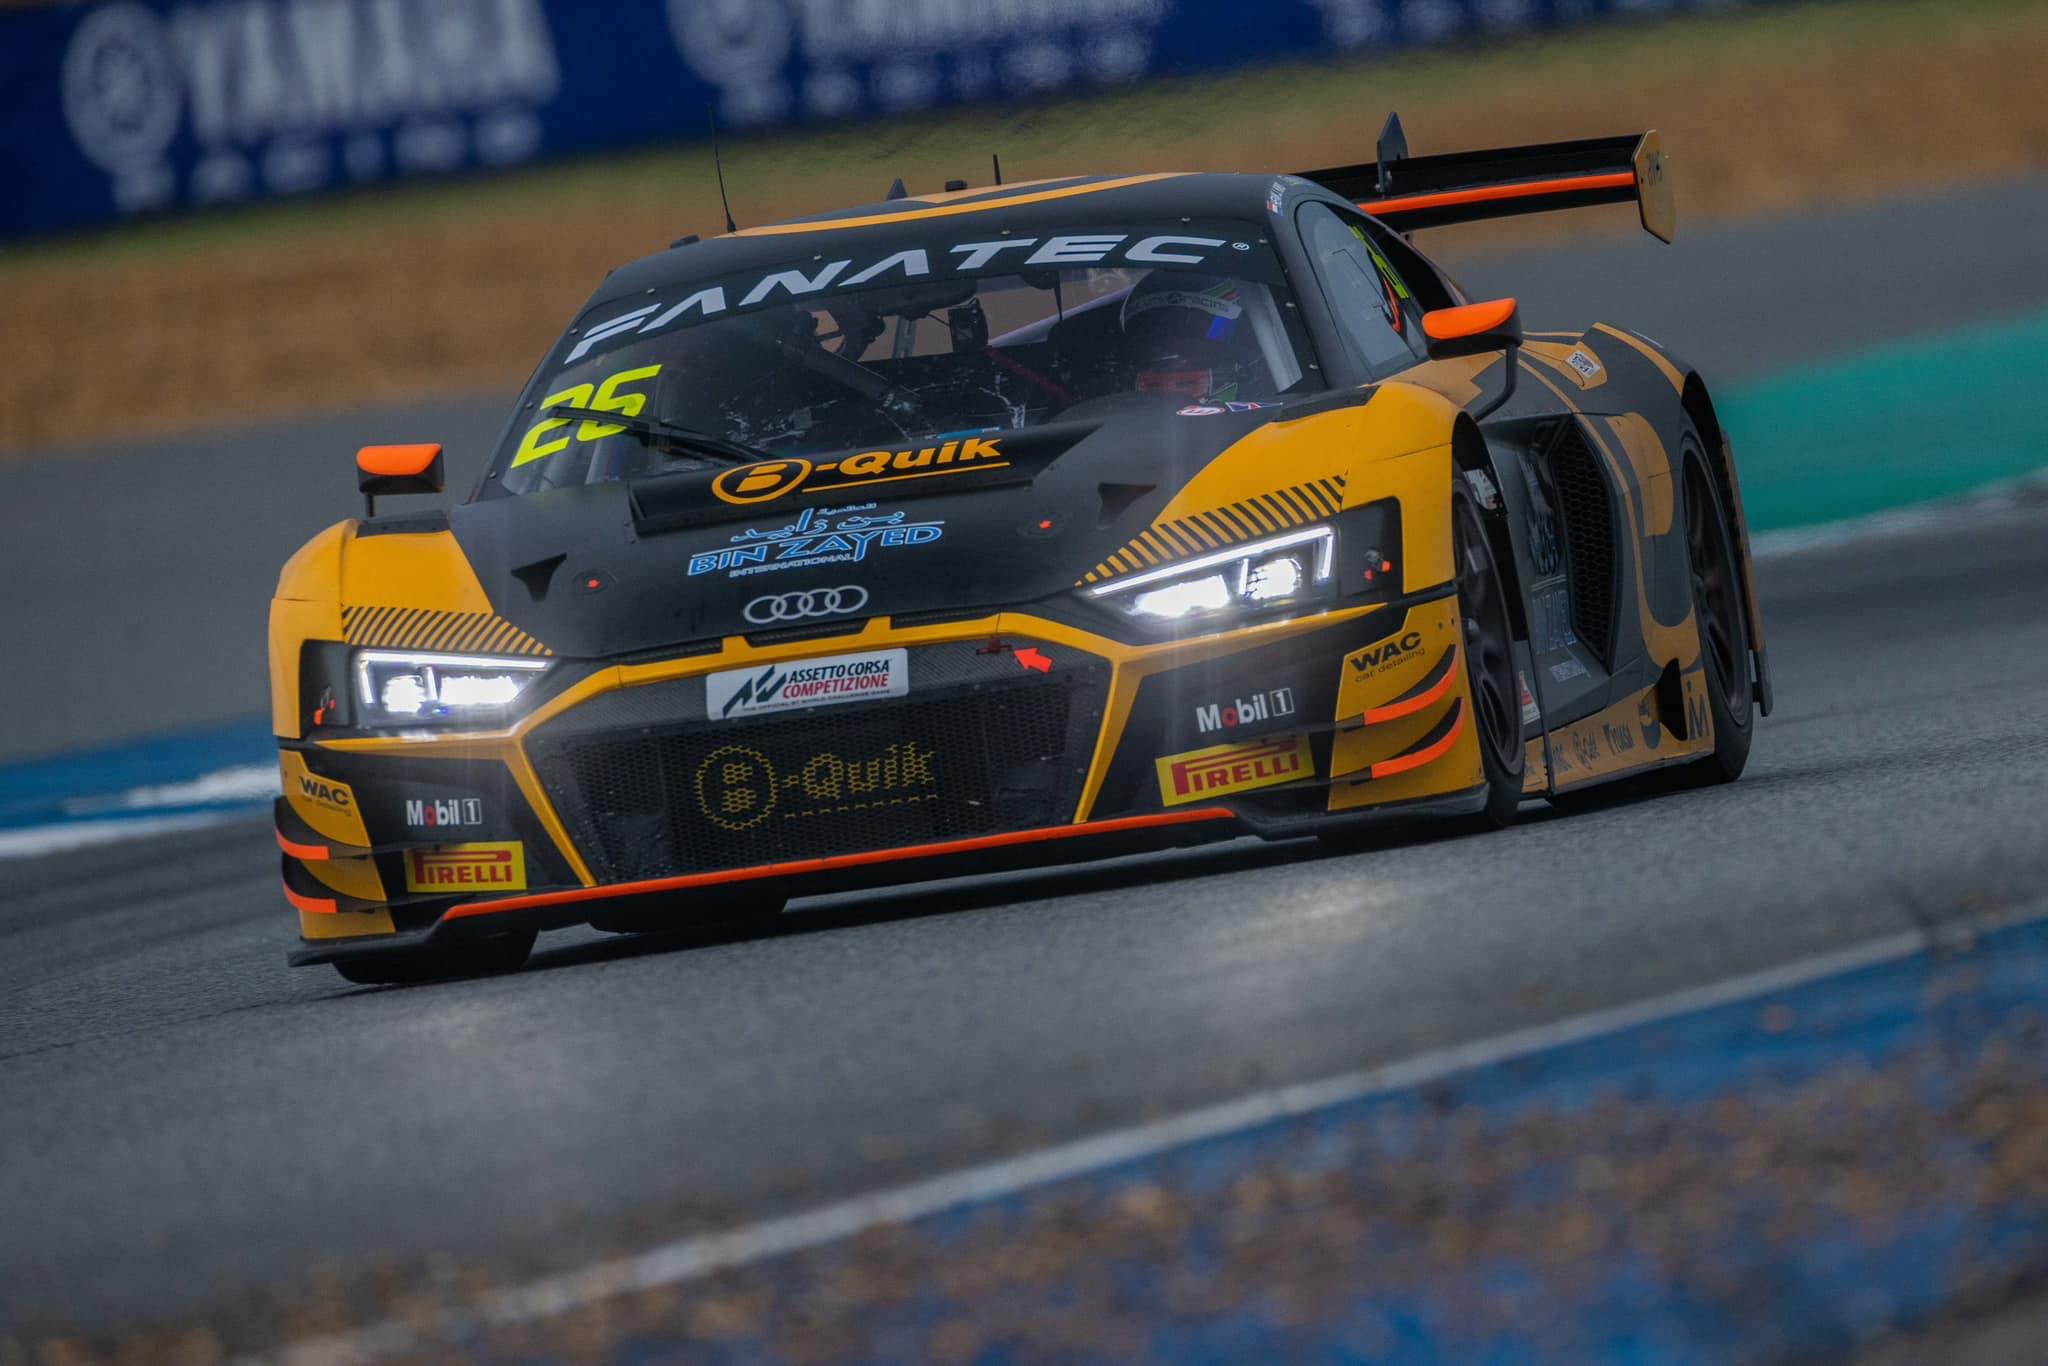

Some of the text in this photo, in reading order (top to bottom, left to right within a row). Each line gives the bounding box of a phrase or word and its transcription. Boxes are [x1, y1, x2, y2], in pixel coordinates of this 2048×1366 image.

[564, 234, 1228, 364] FANATEC
[511, 364, 662, 468] 26
[724, 438, 1003, 498] B-Quik
[687, 526, 943, 576] BIN ZAYED
[729, 553, 857, 578] INTERNATIONAL
[1350, 631, 1422, 672] WAC
[1354, 648, 1425, 683] car detailing
[783, 673, 889, 699] COMPETIZIONE
[788, 659, 890, 684] ASSETTO CORSA
[1195, 689, 1291, 733] Mobil 1
[1171, 739, 1299, 796] PIRELLI
[298, 775, 350, 806] WAC
[406, 799, 479, 826] Mobil 1
[415, 850, 513, 884] PIRELLI
